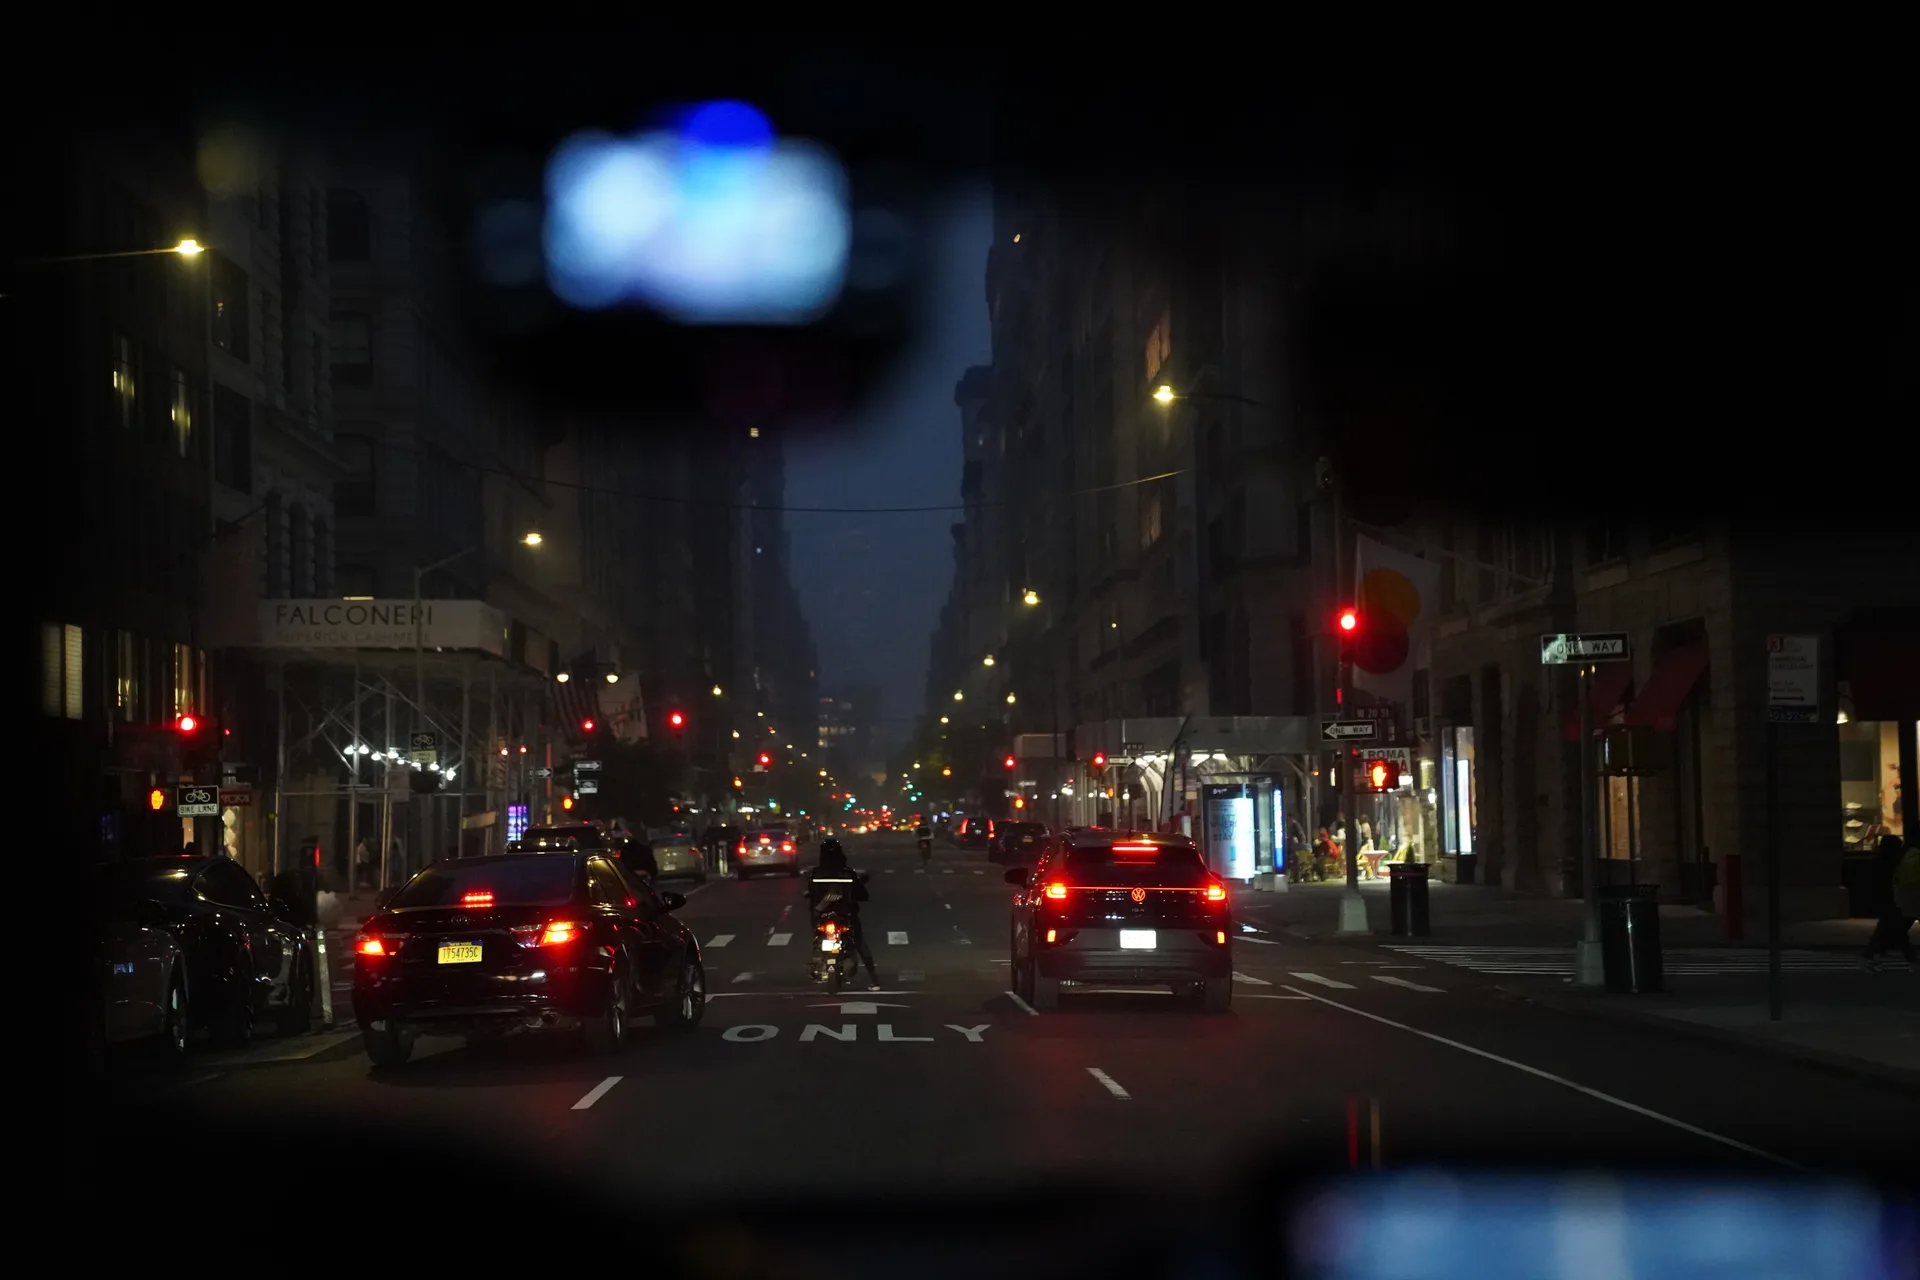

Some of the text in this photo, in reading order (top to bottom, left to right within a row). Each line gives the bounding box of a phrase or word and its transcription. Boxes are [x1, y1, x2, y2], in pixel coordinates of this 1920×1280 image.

[1556, 641, 1617, 655] ONE WAY
[1330, 726, 1370, 735] ONE WAY
[1367, 749, 1406, 759] ROMA
[180, 804, 216, 814] BIKE LANE
[722, 1024, 992, 1043] ONLY
